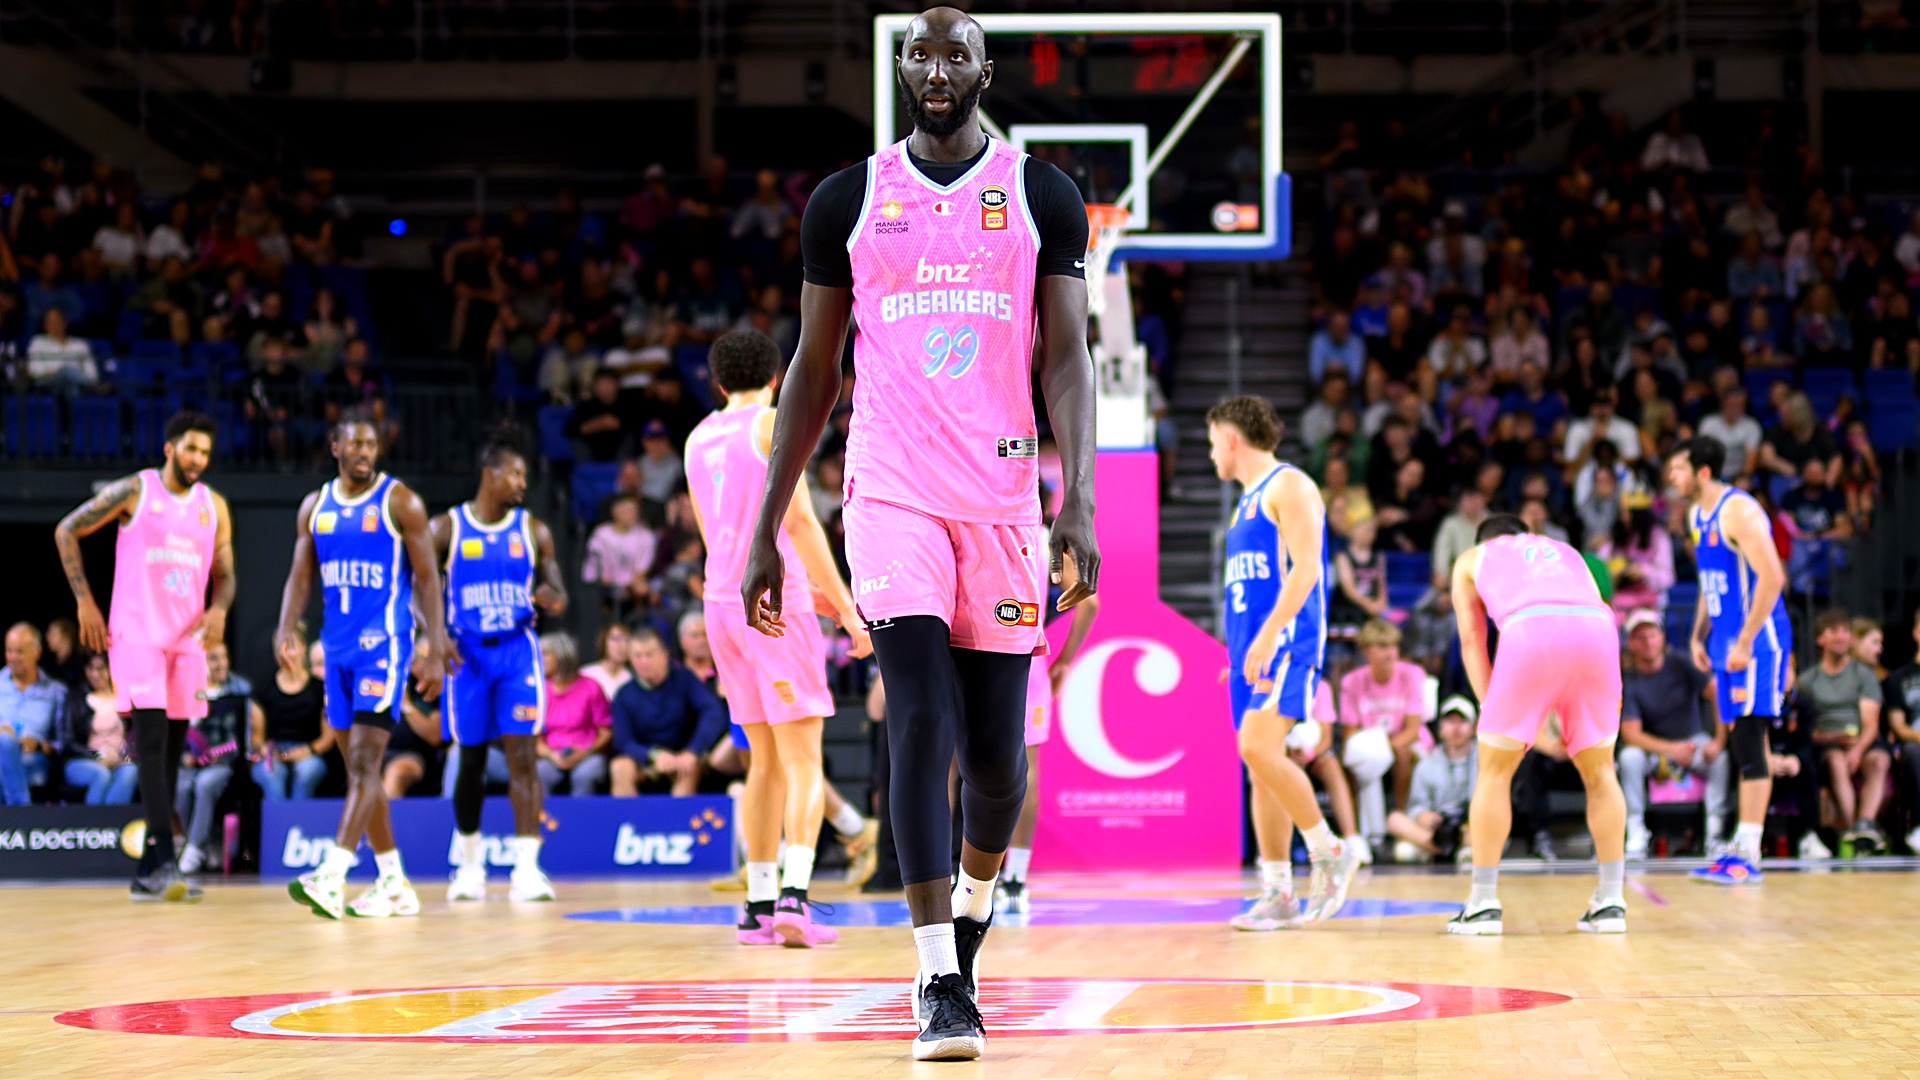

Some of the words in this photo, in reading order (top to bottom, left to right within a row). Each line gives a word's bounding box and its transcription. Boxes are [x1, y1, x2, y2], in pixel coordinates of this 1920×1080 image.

[985, 191, 1002, 203] NBL
[916, 258, 970, 283] bnz
[881, 289, 1013, 322] BREAKERS
[921, 325, 979, 378] 99
[860, 575, 890, 595] bnz
[1231, 582, 1247, 613] 2
[339, 586, 349, 614] 1
[1000, 606, 1017, 619] NBL
[480, 606, 514, 632] 23
[29, 830, 117, 850] DOCTOR
[613, 823, 696, 865] bnz
